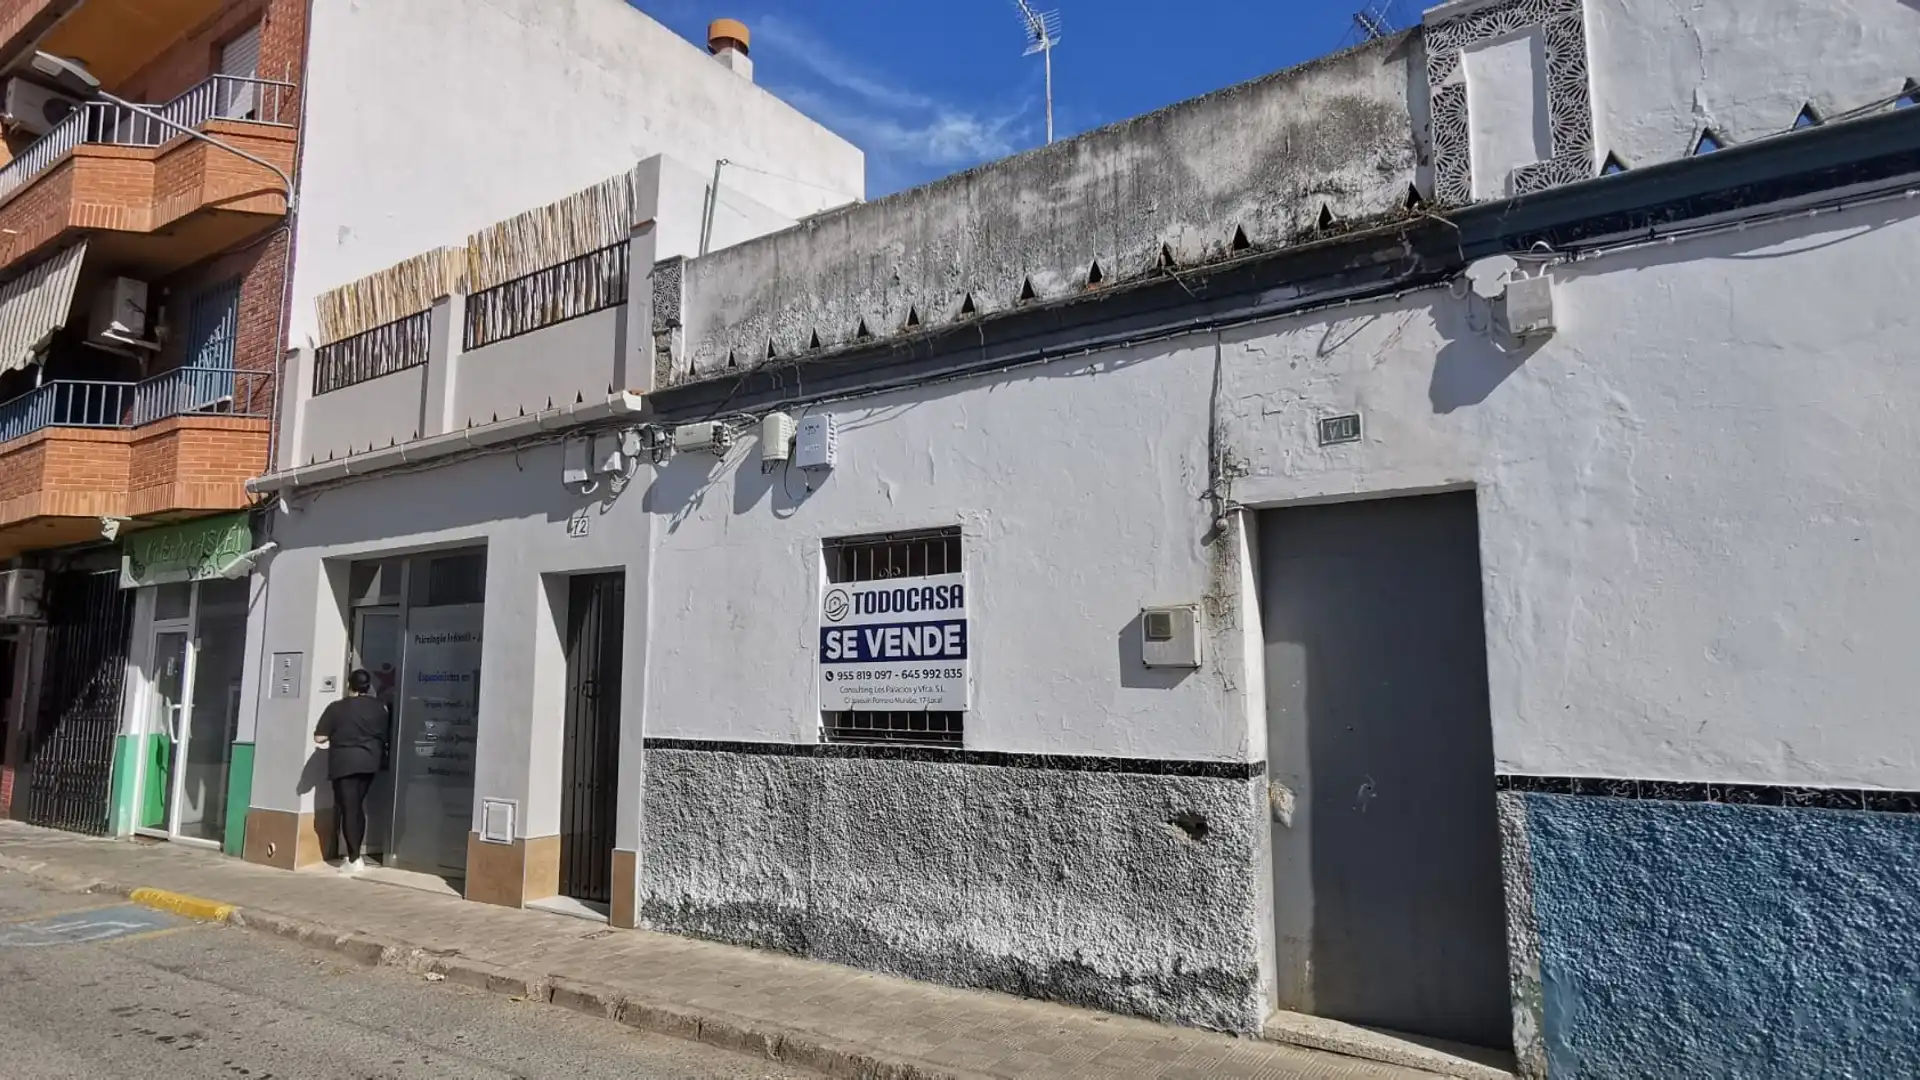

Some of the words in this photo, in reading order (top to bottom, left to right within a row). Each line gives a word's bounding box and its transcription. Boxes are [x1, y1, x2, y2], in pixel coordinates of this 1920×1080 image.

[573, 519, 586, 535] 72
[852, 584, 964, 615] TODOCASA
[826, 630, 858, 660] SE
[864, 624, 962, 658] VENDE
[837, 671, 854, 681] 955
[856, 670, 872, 680] 819
[874, 670, 892, 680] 097
[901, 669, 920, 679] 645
[922, 669, 941, 679] 992
[943, 668, 963, 678] 835
[839, 685, 873, 695] Consulting
[874, 685, 885, 694] Los
[885, 684, 912, 694] Palacios
